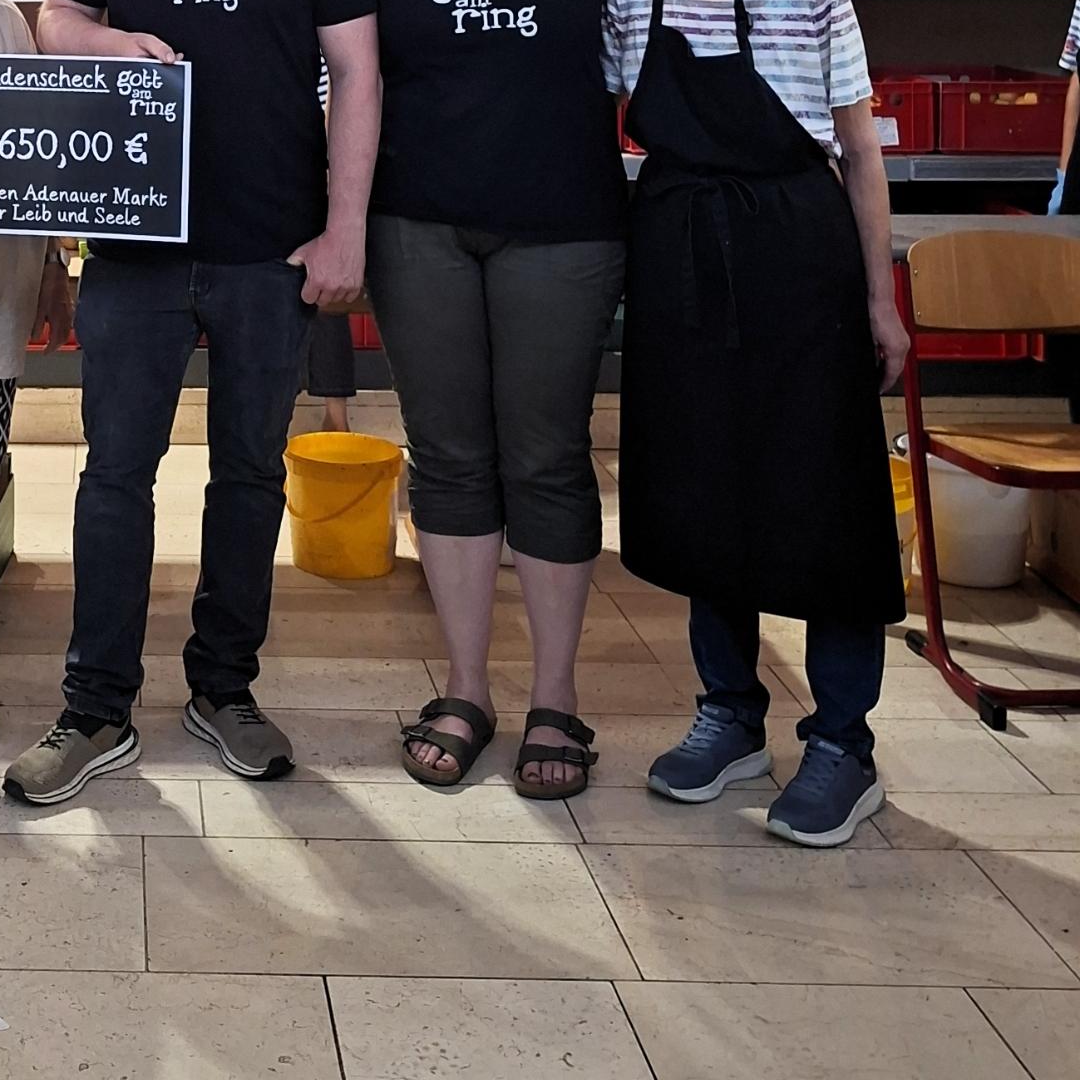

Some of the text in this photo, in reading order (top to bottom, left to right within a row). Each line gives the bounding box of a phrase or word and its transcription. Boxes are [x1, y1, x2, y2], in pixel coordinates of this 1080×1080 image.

[451, 5, 538, 37] ring
[116, 69, 163, 95] gott
[131, 89, 152, 99] am
[129, 99, 177, 122] ring
[124, 132, 148, 164] €
[23, 184, 107, 203] Adenauer
[112, 186, 168, 207] Markt
[12, 203, 52, 221] Leib
[57, 207, 89, 224] und
[94, 207, 141, 226] Seele
